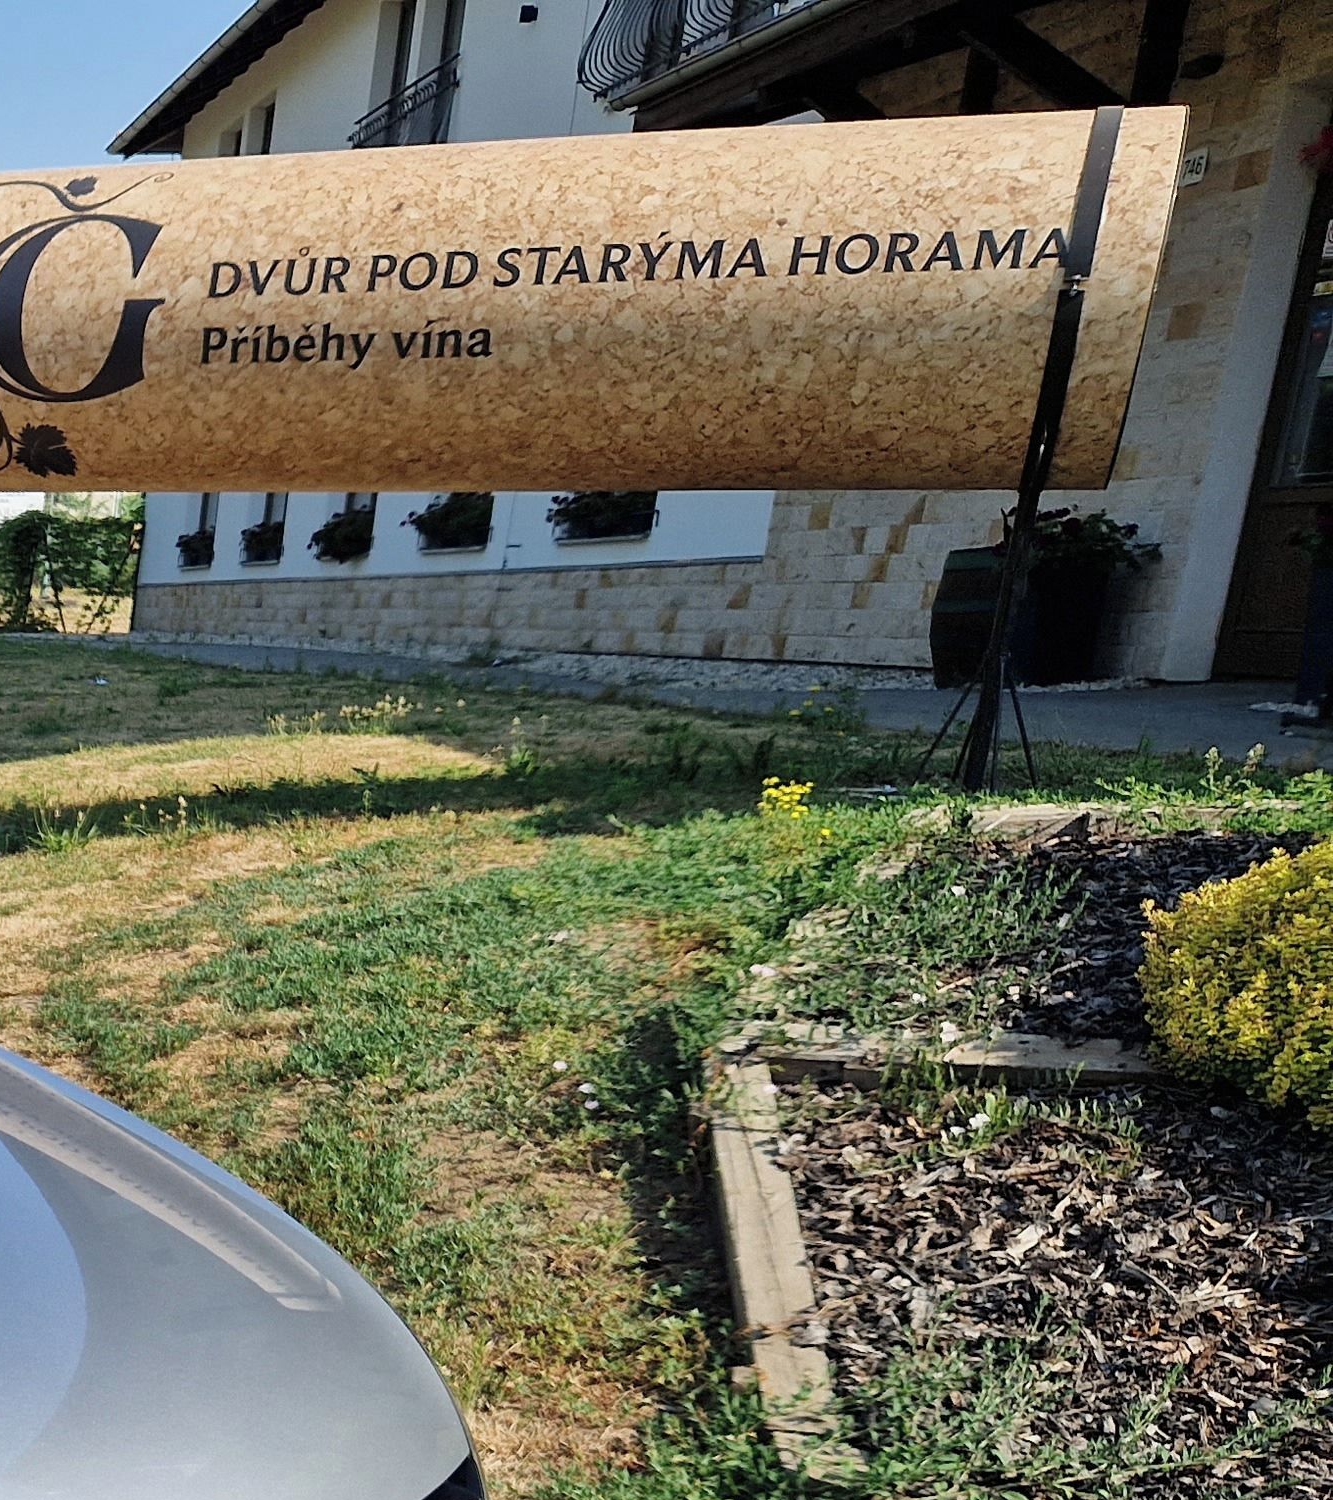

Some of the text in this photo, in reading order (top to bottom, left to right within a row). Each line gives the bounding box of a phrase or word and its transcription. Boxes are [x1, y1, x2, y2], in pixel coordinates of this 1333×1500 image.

[1182, 155, 1205, 180] 746
[208, 227, 1071, 299] DVŮR POD STARÝMA HORAMA
[198, 319, 493, 371] Příběhy vína
